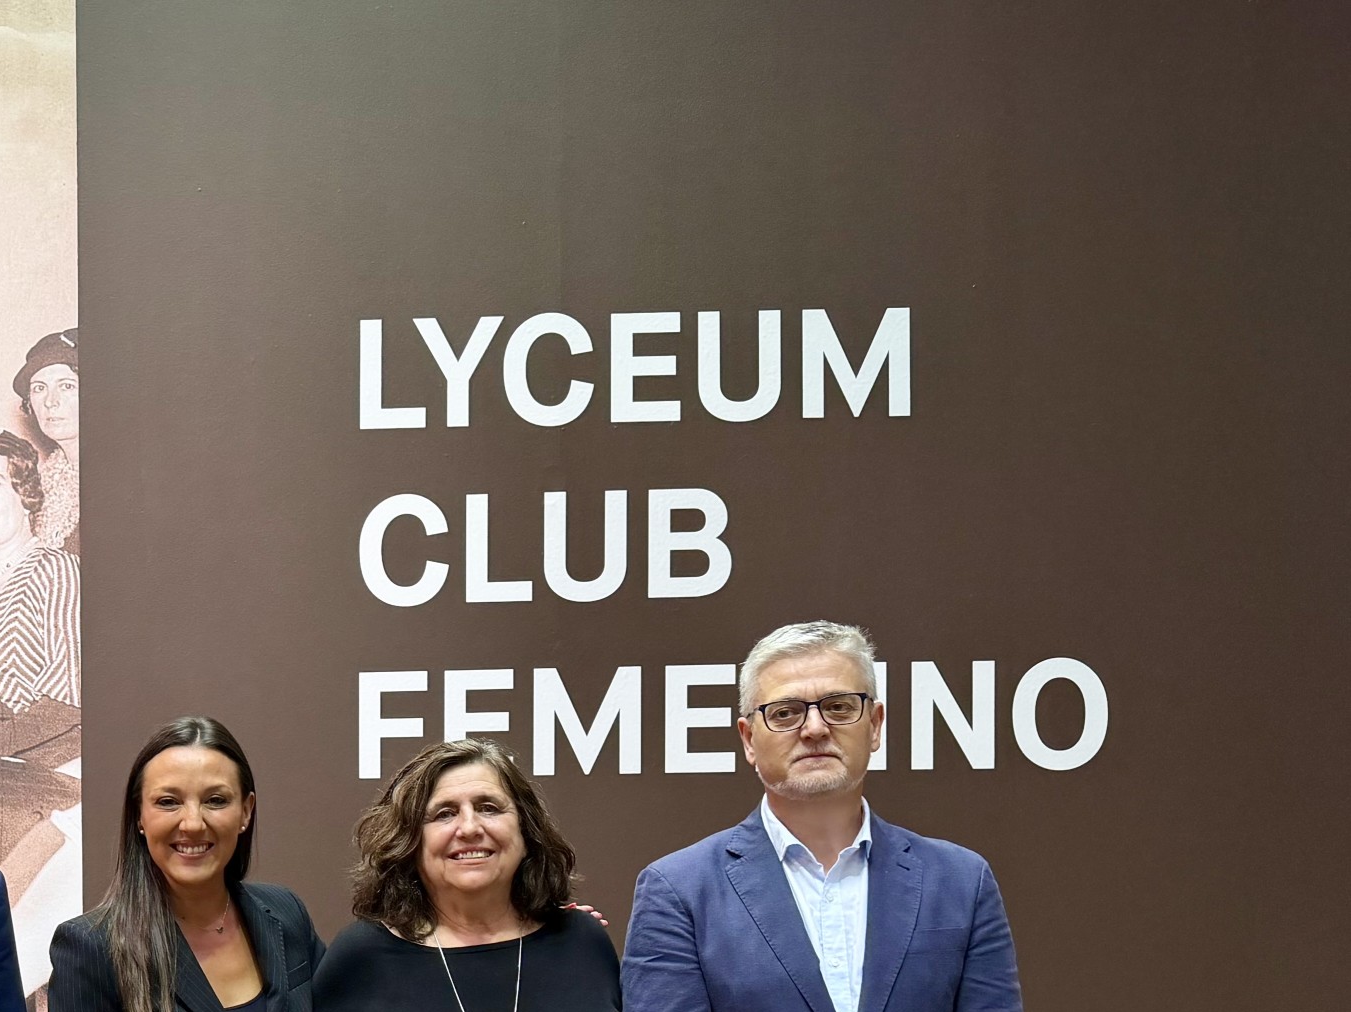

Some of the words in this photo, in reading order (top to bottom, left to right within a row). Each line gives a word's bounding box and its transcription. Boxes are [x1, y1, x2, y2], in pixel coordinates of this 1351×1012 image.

[359, 307, 911, 430] LYCEUM
[358, 488, 733, 608] CLUB
[358, 657, 1109, 780] FEMENO
